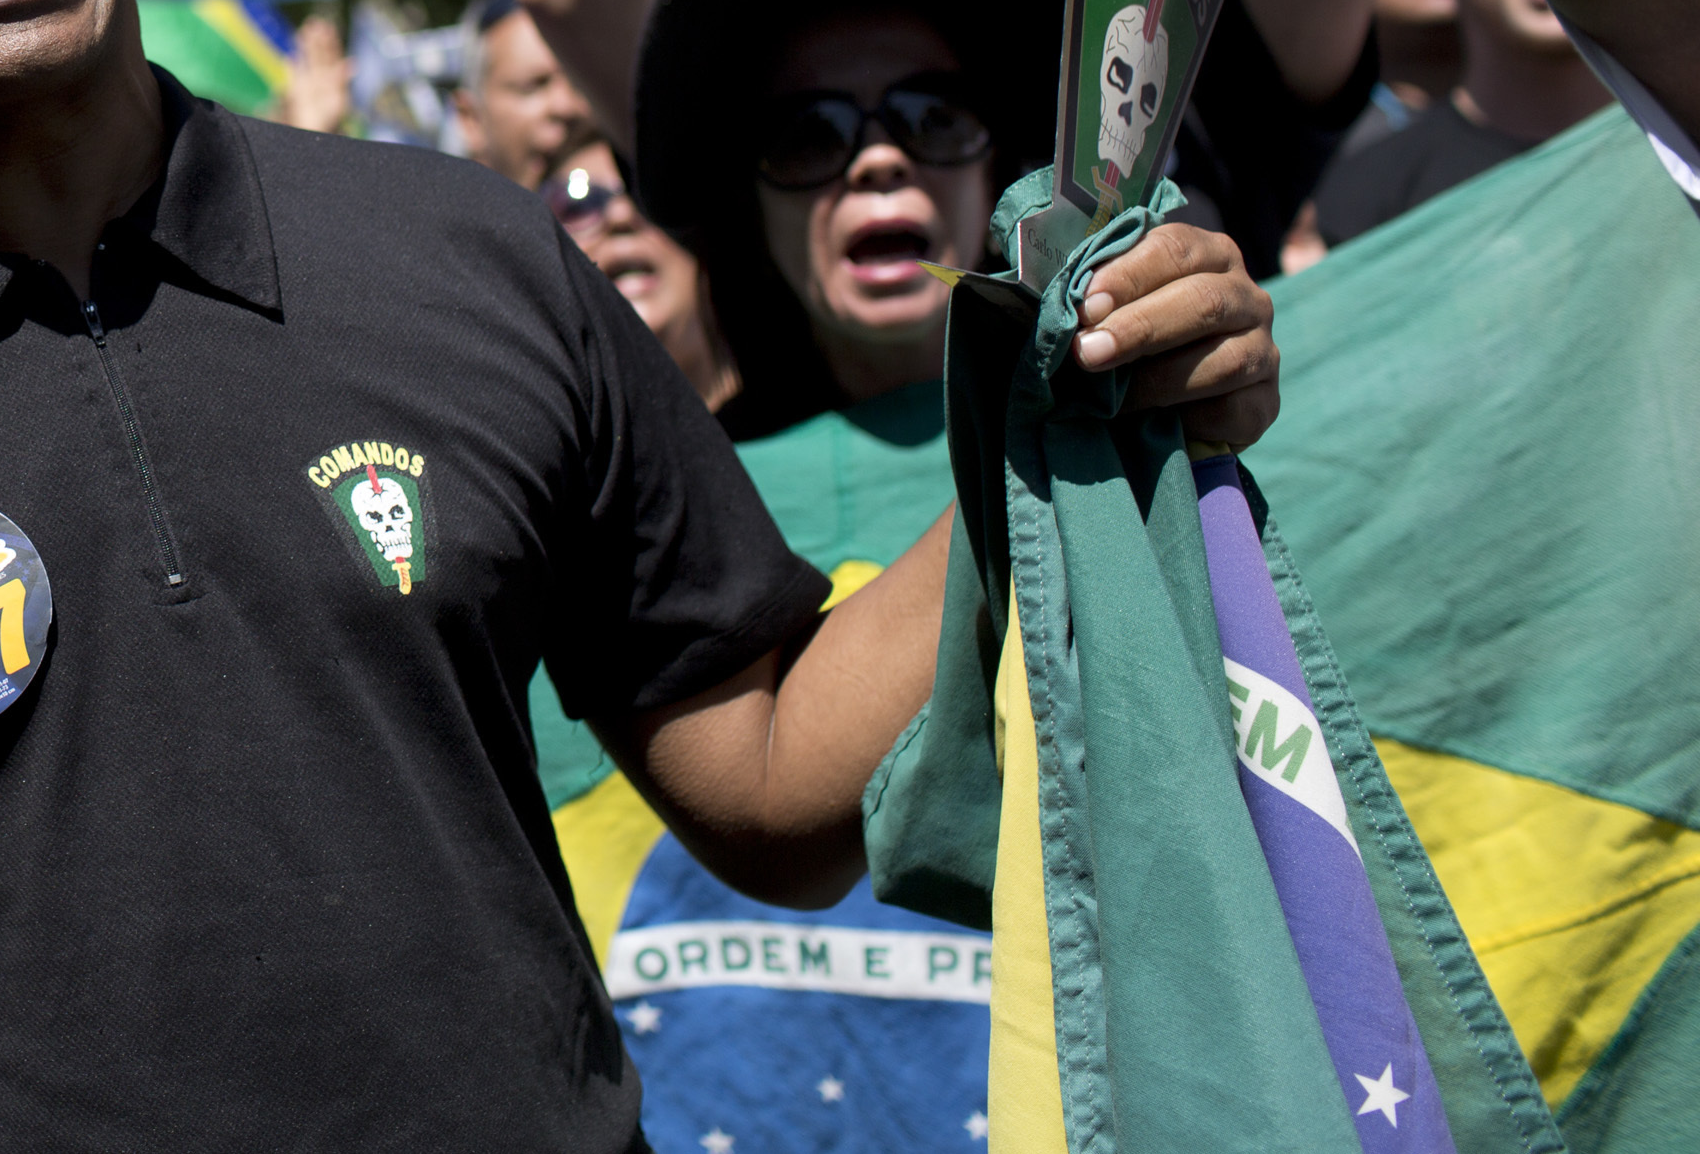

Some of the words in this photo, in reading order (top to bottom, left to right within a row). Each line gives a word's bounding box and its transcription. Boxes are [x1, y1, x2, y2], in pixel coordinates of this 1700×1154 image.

[308, 441, 424, 488] COMANDOS
[634, 934, 832, 982] ORDEM
[864, 946, 894, 979] E
